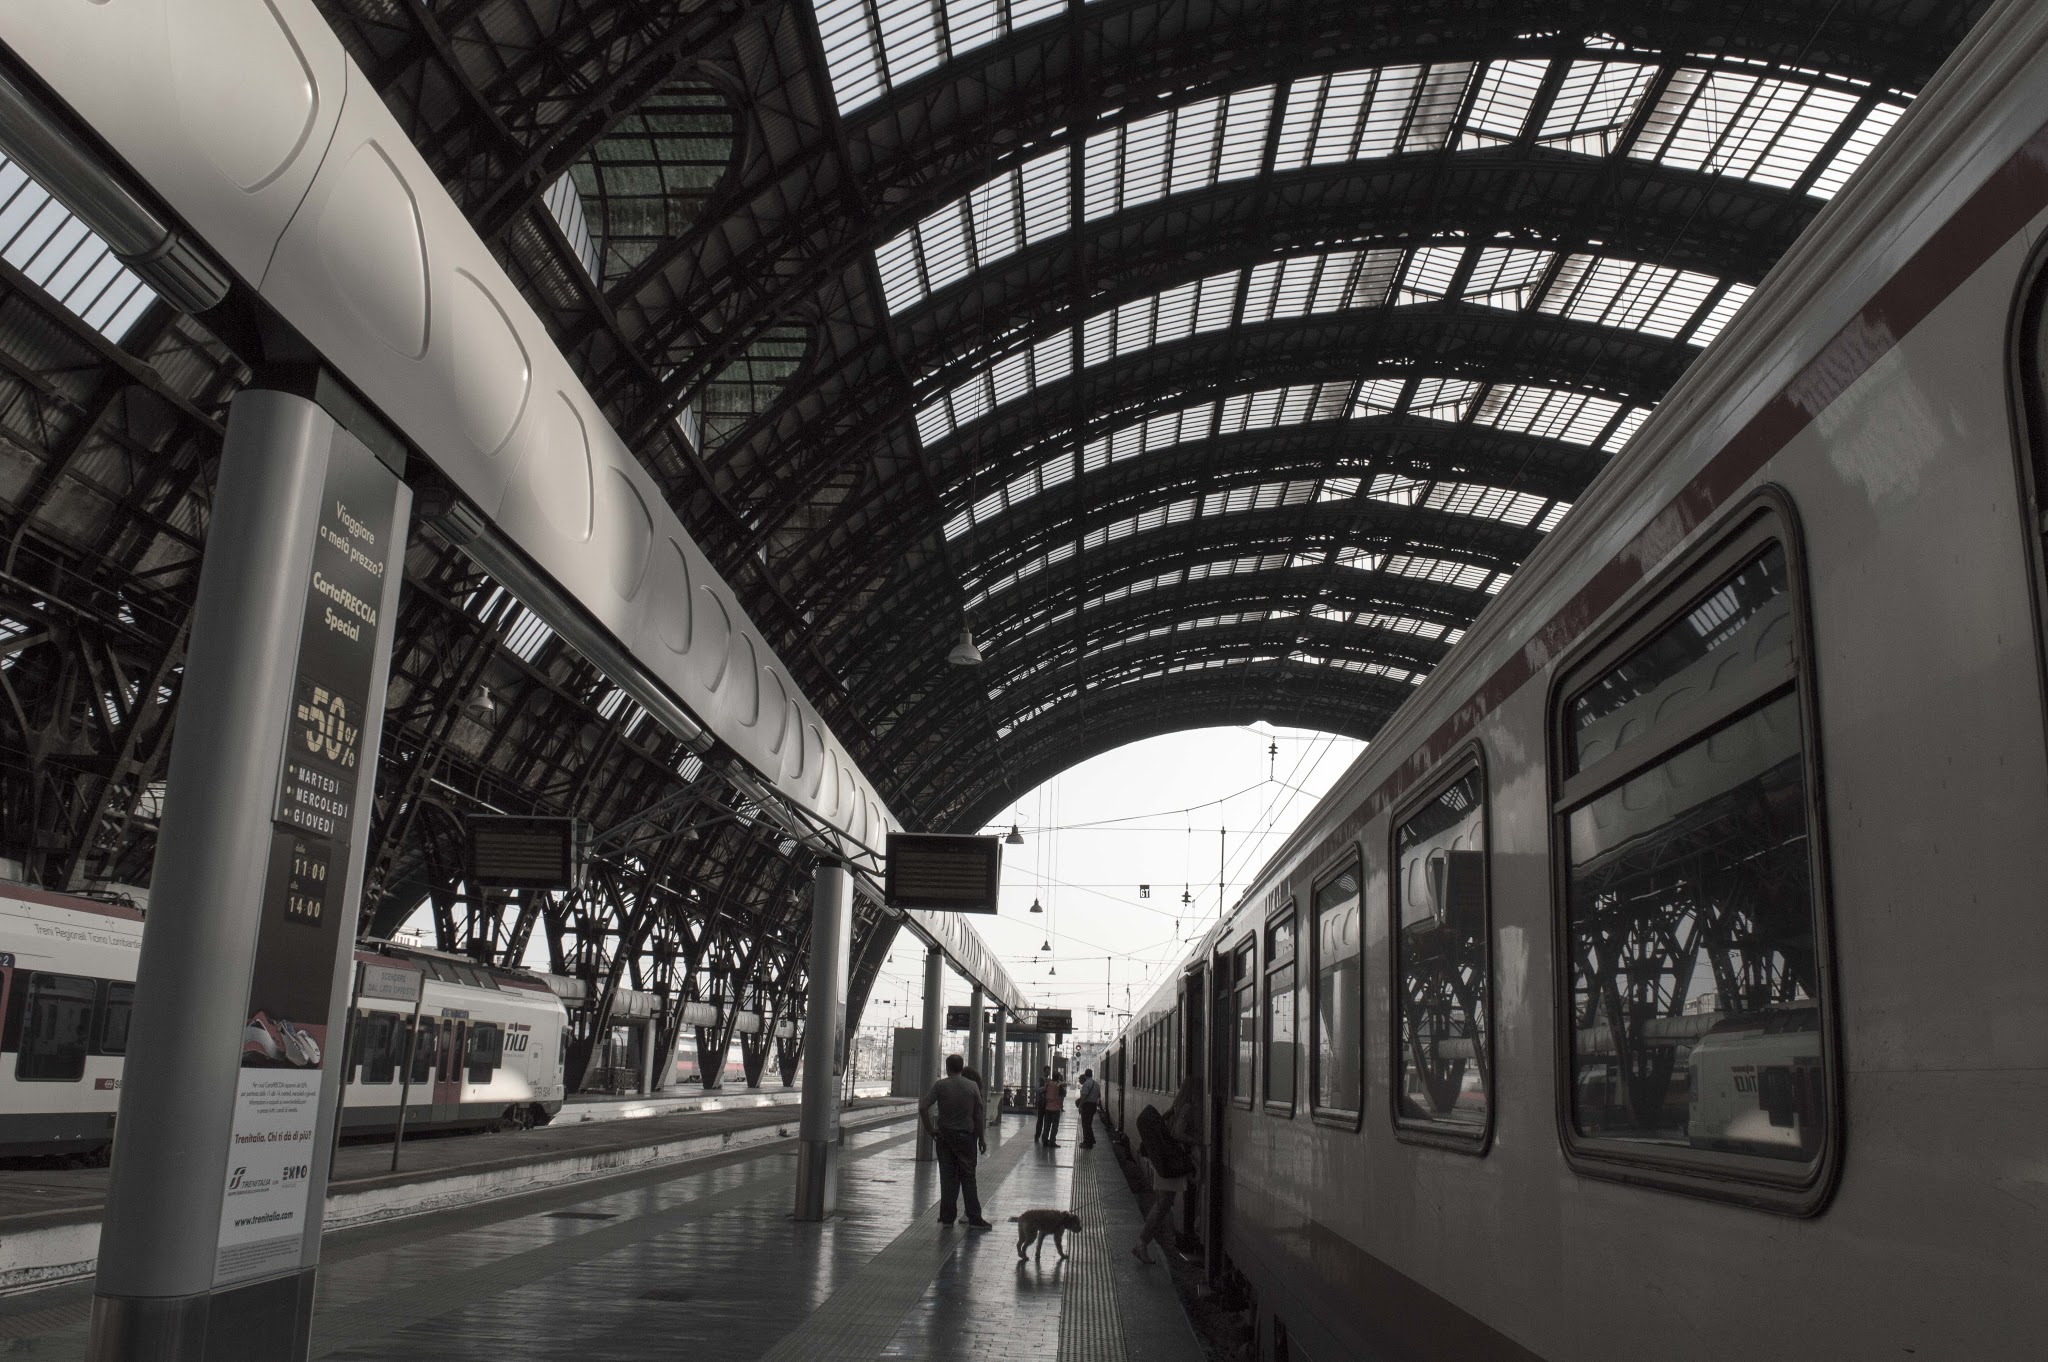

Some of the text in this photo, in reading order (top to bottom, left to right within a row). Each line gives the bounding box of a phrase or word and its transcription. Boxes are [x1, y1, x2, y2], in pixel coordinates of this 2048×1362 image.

[336, 501, 375, 545] Viaggiare
[320, 525, 384, 578] a metà prezzo?
[313, 571, 377, 627] CartaFRECCIA
[325, 607, 360, 642] Special
[297, 686, 359, 768] -50%
[34, 923, 54, 936] Treni
[55, 927, 87, 941] Regionali
[88, 932, 108, 944] Ticino
[3, 955, 9, 966] 2
[434, 1036, 438, 1051] 1
[467, 1038, 471, 1053] 1
[504, 1033, 529, 1052] TILO
[235, 1133, 266, 1144] Trenitalia.
[268, 1131, 278, 1142] Chi
[292, 1130, 299, 1140] di
[282, 1165, 308, 1181] EXPO
[242, 1178, 271, 1189] TRENITALIA
[234, 1211, 294, 1227] www.trenitalia.com
